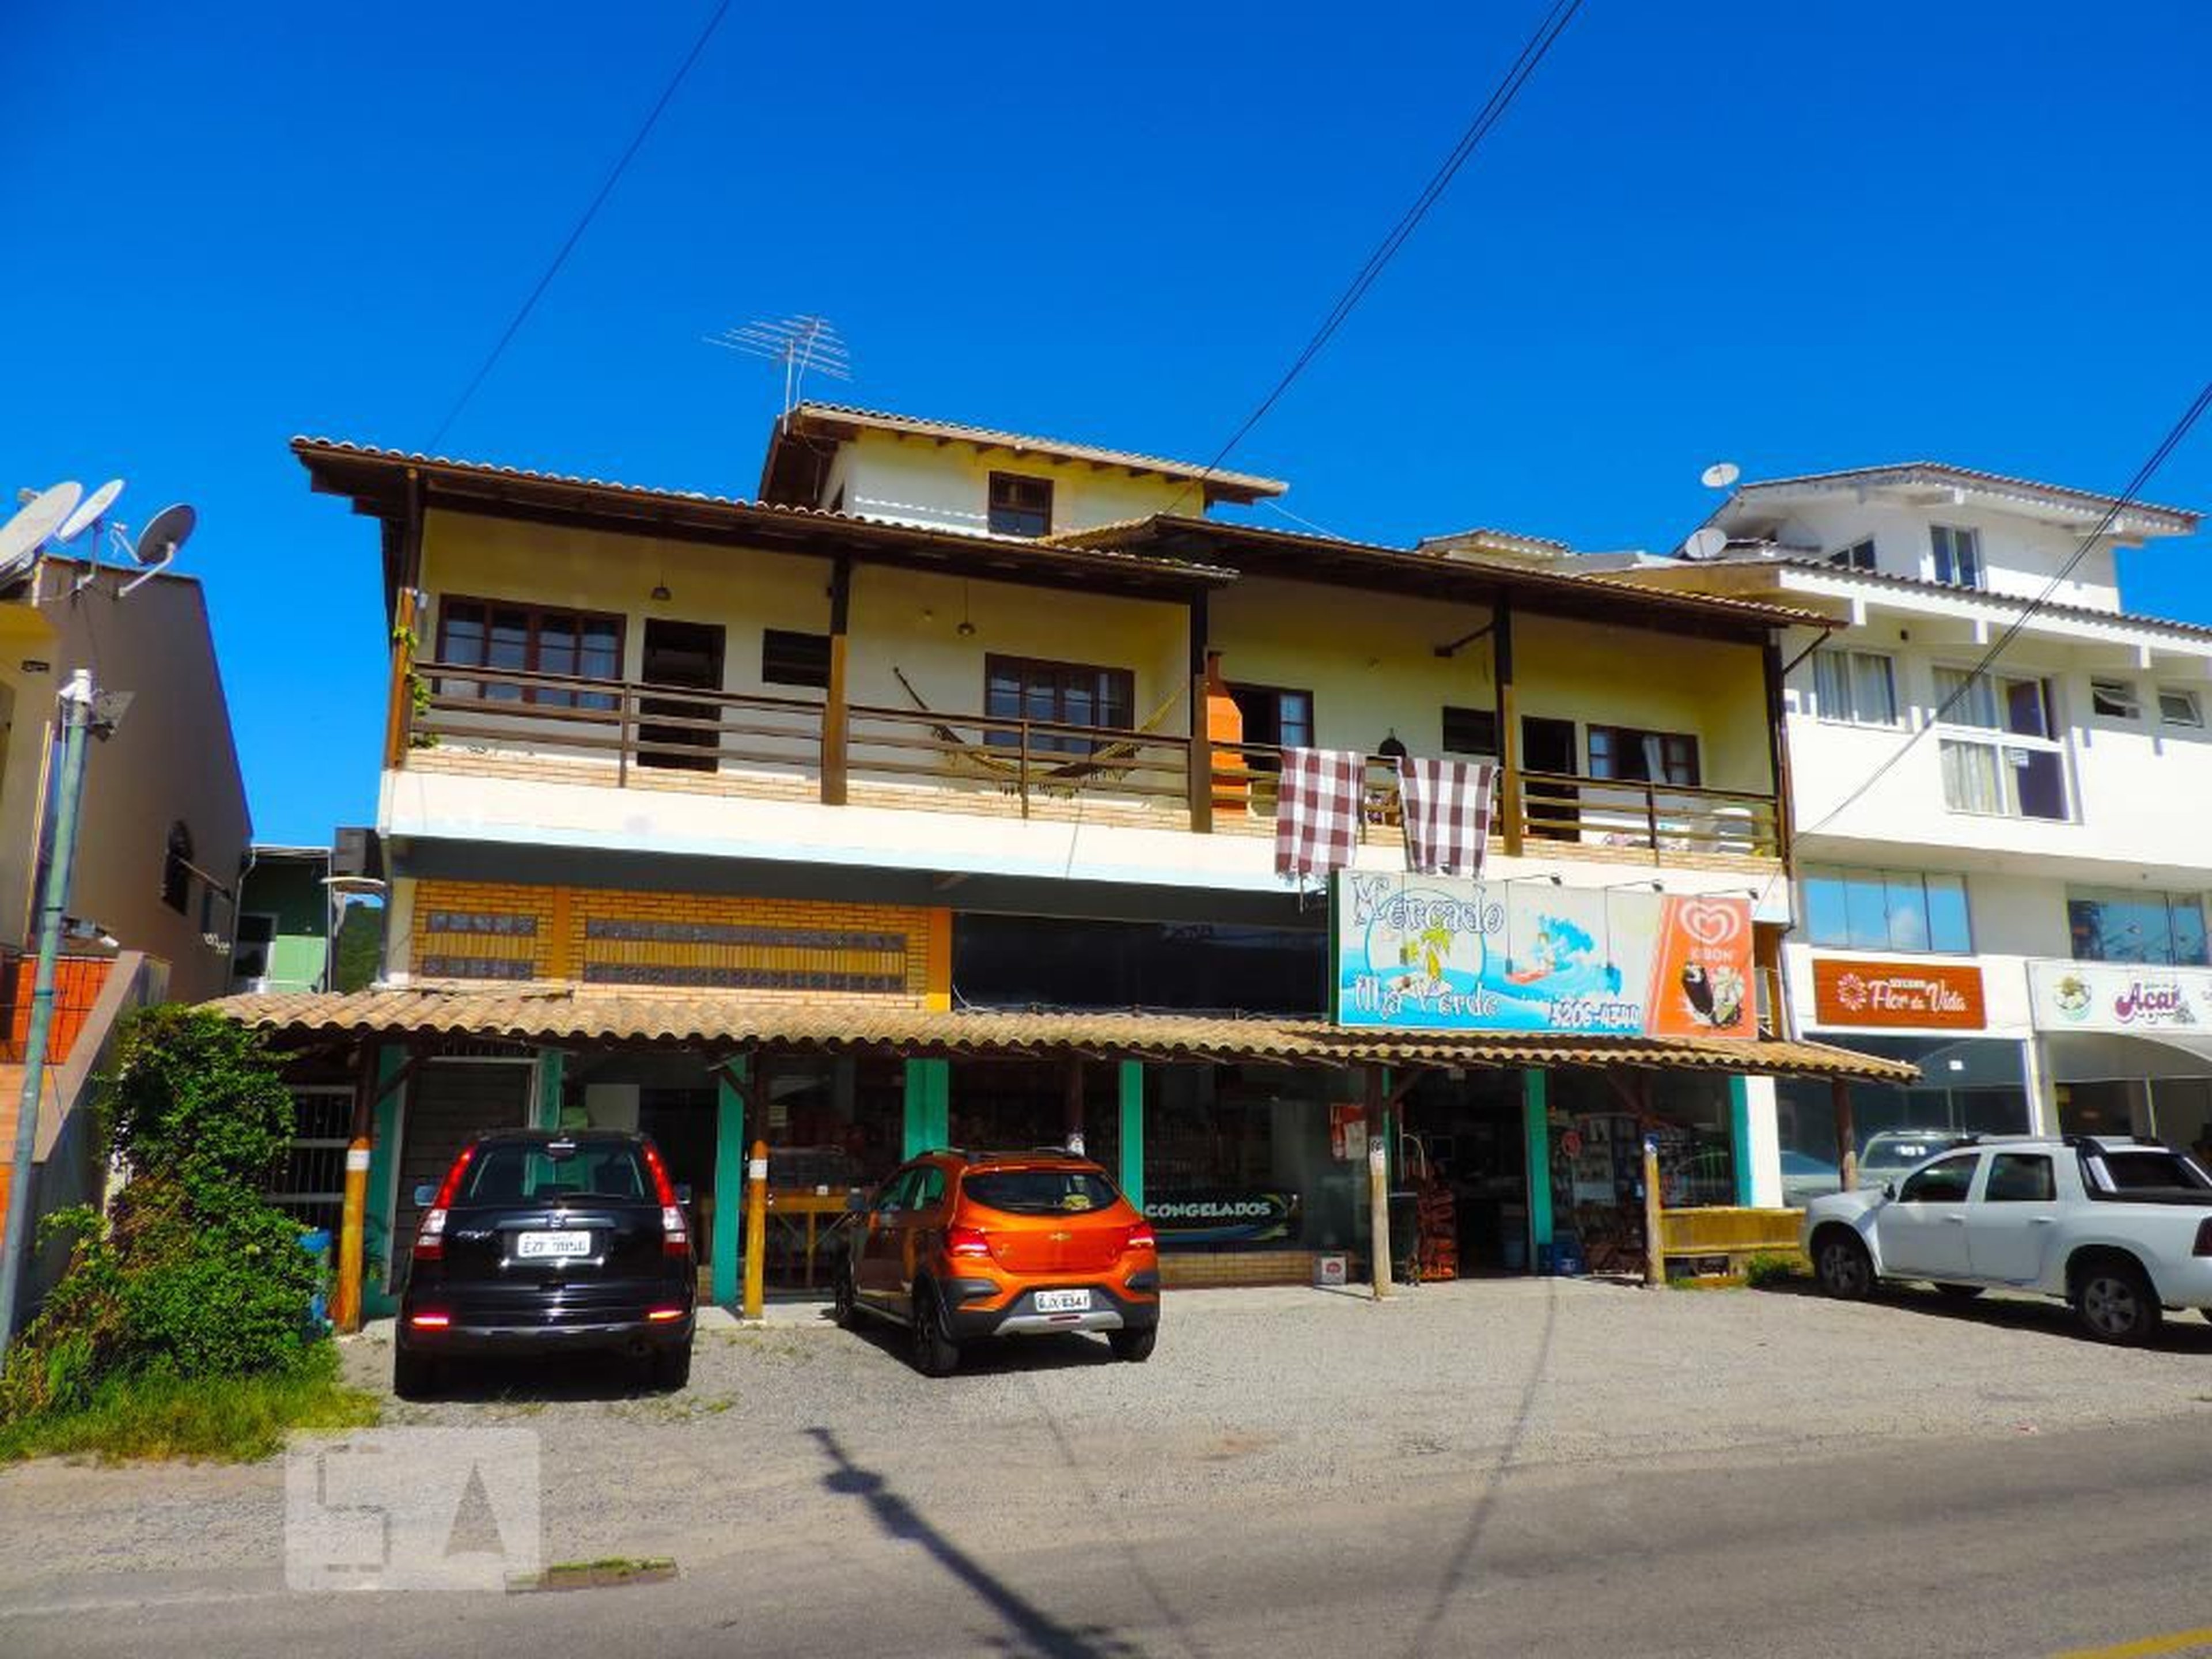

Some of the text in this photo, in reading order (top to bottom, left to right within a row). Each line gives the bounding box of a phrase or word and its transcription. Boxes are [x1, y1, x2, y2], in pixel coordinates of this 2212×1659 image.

[1351, 874, 1504, 933] Mercado
[1868, 980, 1909, 1012] Flor
[1925, 979, 1967, 1012] Vida
[1146, 1202, 1271, 1218] CONGELADOS
